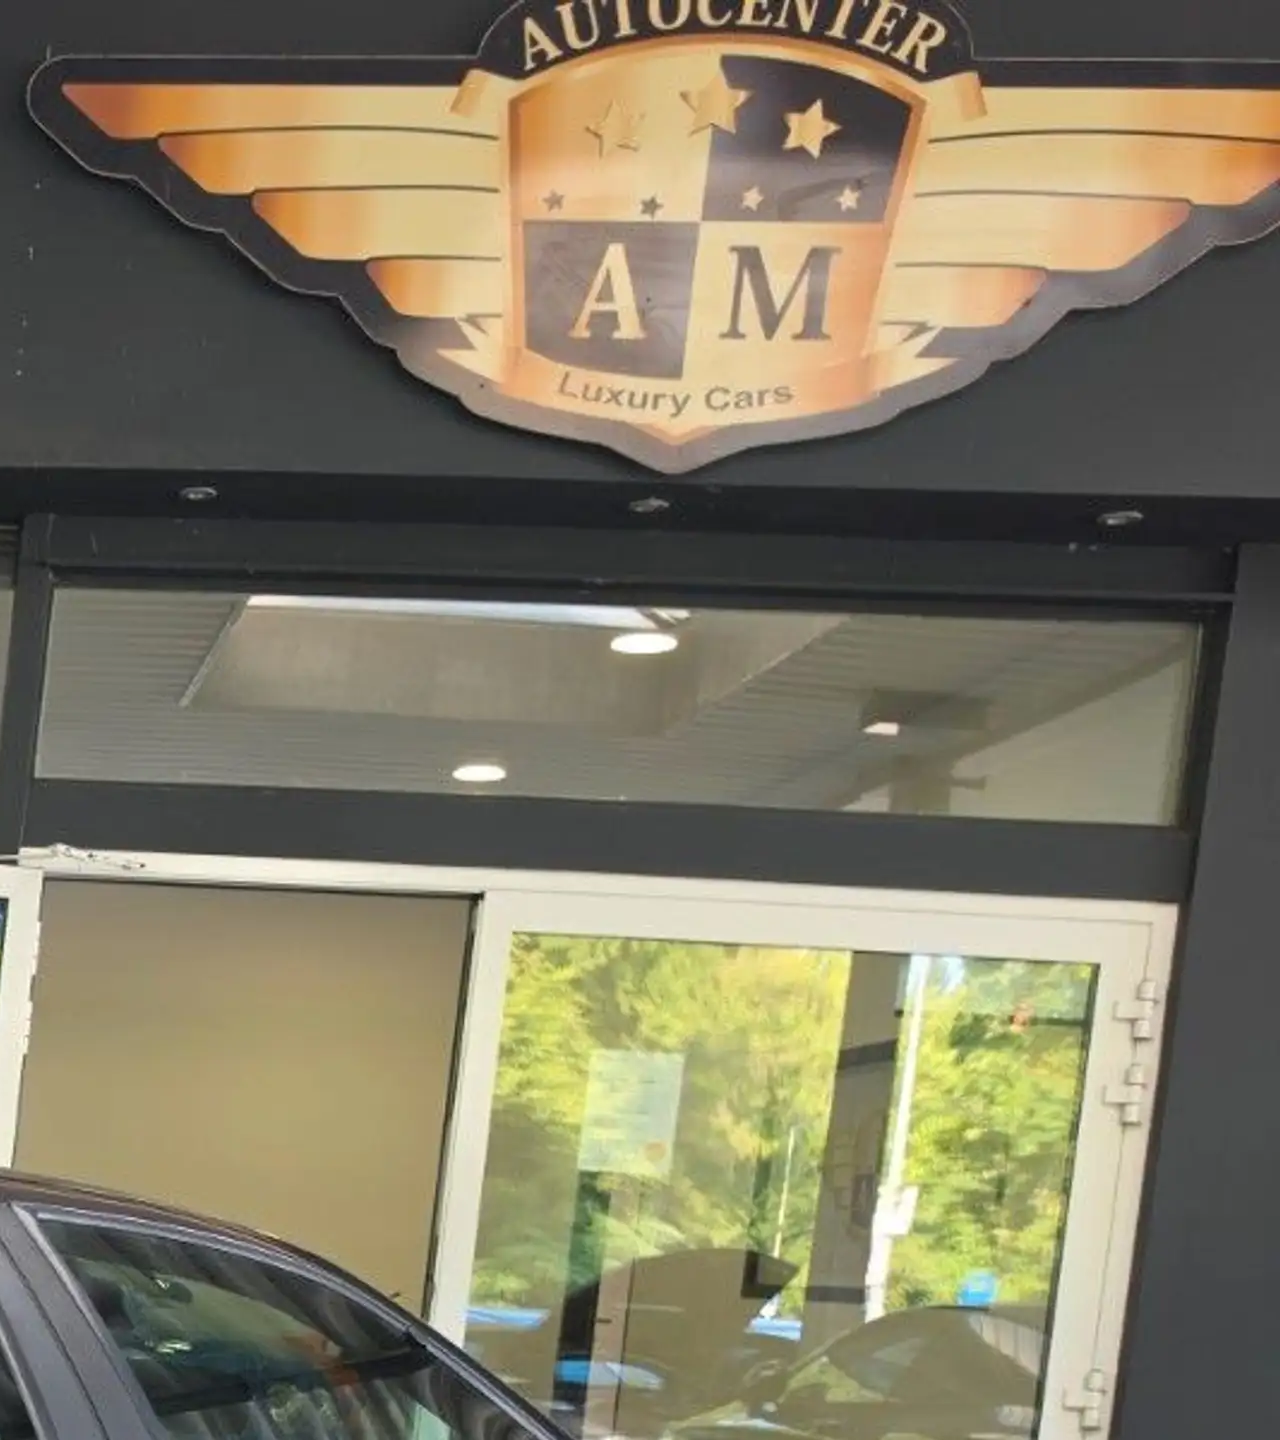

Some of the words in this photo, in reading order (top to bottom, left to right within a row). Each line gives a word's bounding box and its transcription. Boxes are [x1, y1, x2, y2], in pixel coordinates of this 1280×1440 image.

[522, 0, 947, 74] AUTOCENTER
[556, 370, 692, 419] Luxury
[704, 384, 794, 412] Cars
